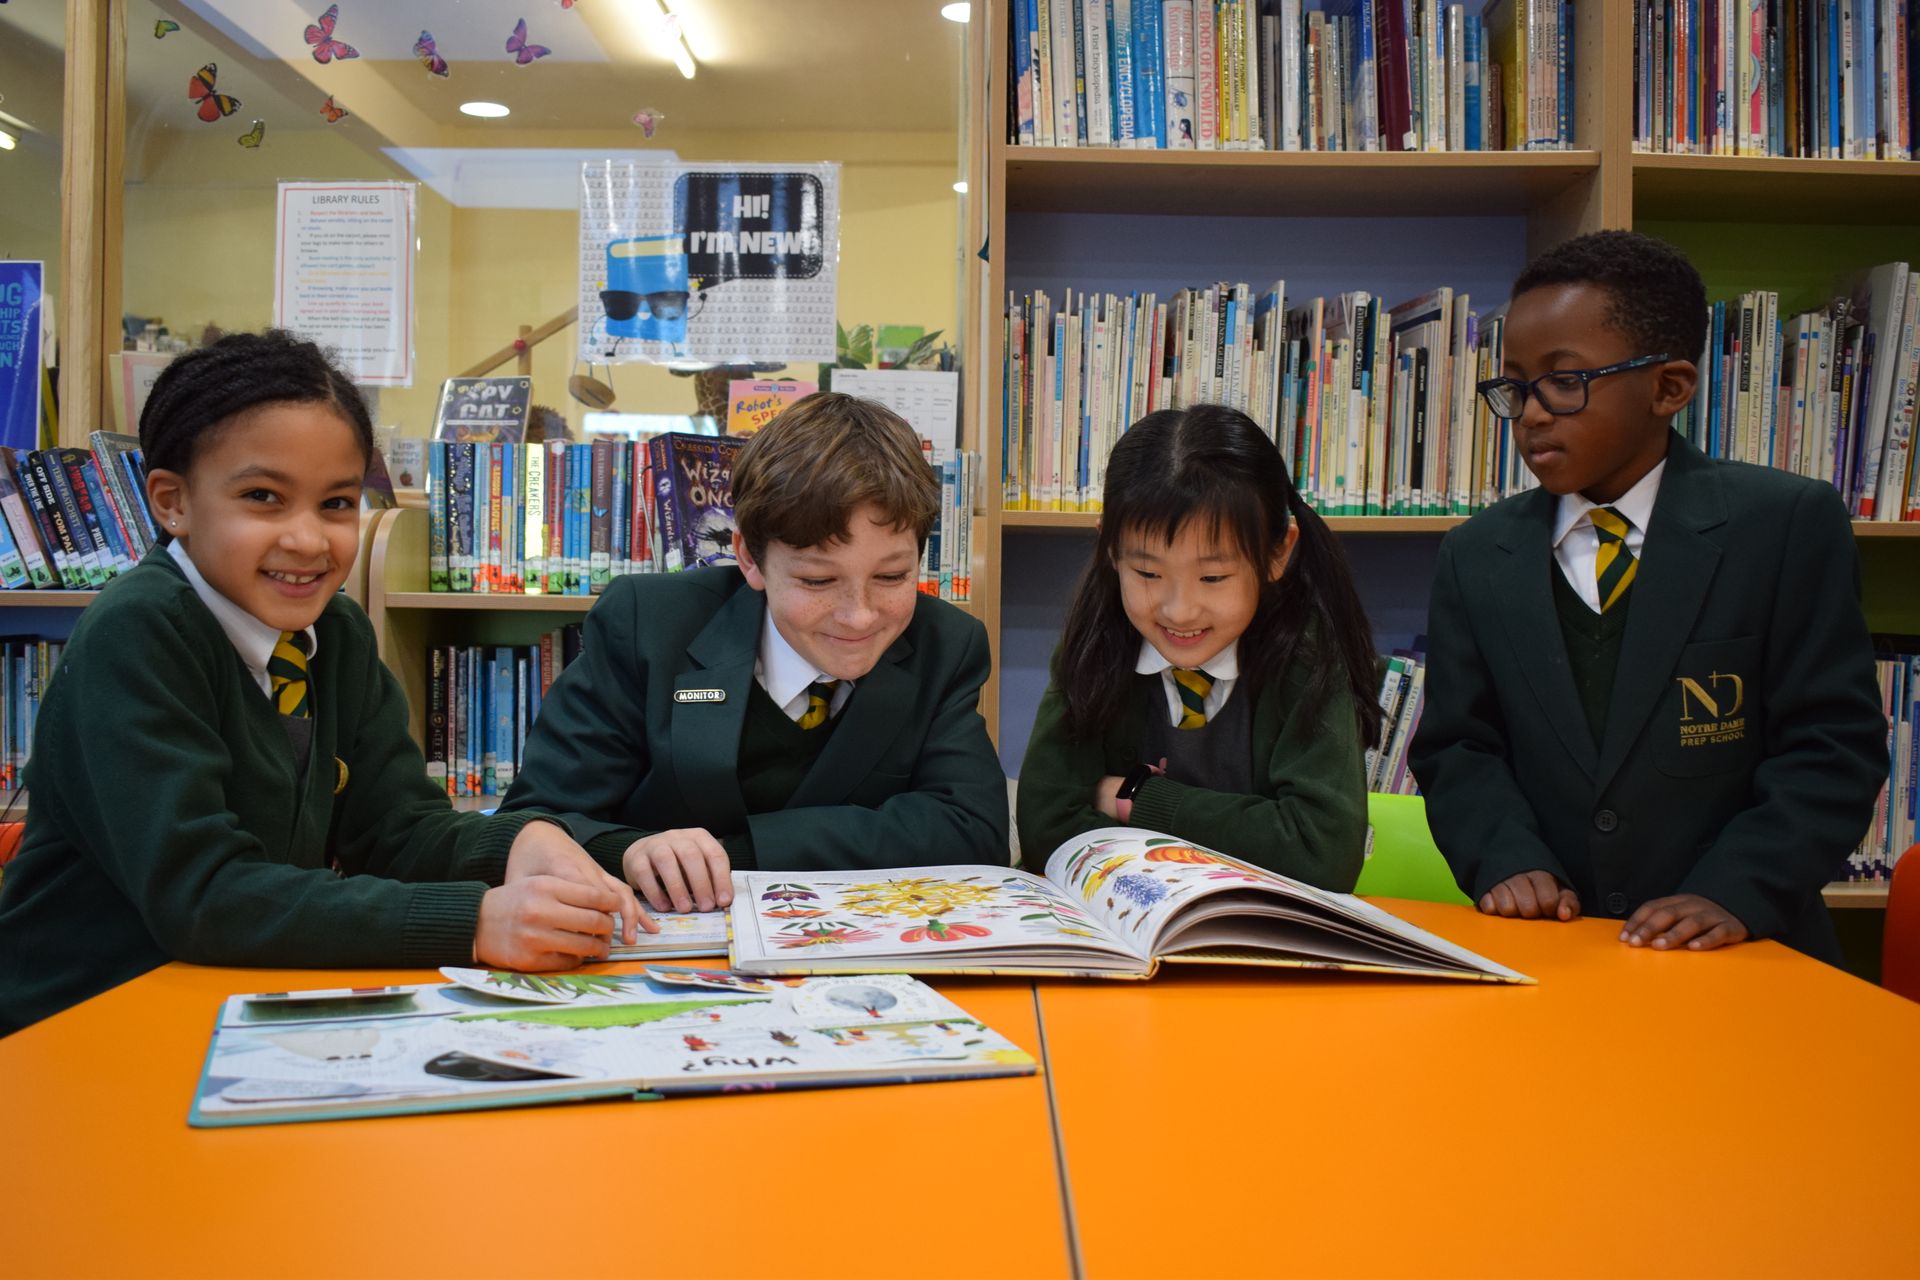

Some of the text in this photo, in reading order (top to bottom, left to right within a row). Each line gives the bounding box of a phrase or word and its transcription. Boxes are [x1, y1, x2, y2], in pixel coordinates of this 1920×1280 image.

[1092, 34, 1100, 51] First
[1168, 6, 1181, 71] Knowledge
[1183, 10, 1194, 68] BIG BOOK
[1845, 25, 1853, 58] SHIPS
[1092, 53, 1102, 105] Encyclopedia
[1200, 10, 1213, 140] BOOK OF KNOWLED
[1118, 58, 1134, 141] ENCYCLOPEDIA
[312, 195, 380, 204] LIBRARY RULES
[733, 195, 770, 219] HI!
[1895, 276, 1906, 314] Some Body!
[1216, 297, 1228, 377] EYEWITNESS GUIDES
[1352, 297, 1364, 378] EYEWITNESS GUIDES
[1740, 310, 1753, 391] EYEWITNESS GUIDES
[1903, 325, 1913, 352] Outdoor
[466, 384, 514, 401] SPY
[736, 394, 782, 414] Robot's
[1829, 365, 1842, 432] GUIDES SKELETON
[1898, 379, 1907, 396] Book
[460, 404, 510, 418] CAT
[752, 409, 783, 426] SPE
[1752, 395, 1760, 414] Book
[1763, 376, 1773, 447] MEDICINE
[1011, 406, 1019, 444] VIBRATIONS
[1751, 417, 1759, 428] of
[1750, 430, 1759, 453] GREAT
[51, 466, 67, 488] TERRY
[528, 456, 542, 516] THE CREAKERS
[597, 463, 605, 497] IBBOTSON
[681, 456, 731, 483] Wiza
[23, 473, 44, 511] OVER THE LINE
[58, 487, 83, 528] PRATCHETT
[433, 480, 445, 529] THE LAST
[690, 484, 736, 508] ONC
[34, 466, 76, 554] OFF SIDE TOM PAL
[543, 652, 552, 687] PENGUIN
[679, 691, 720, 700] MONITOR
[1403, 685, 1420, 722] SEAGULL
[1680, 718, 1745, 735] NOTRE DAME
[1680, 731, 1745, 748] PREP SCHOOL
[1910, 765, 1918, 788] POETRY
